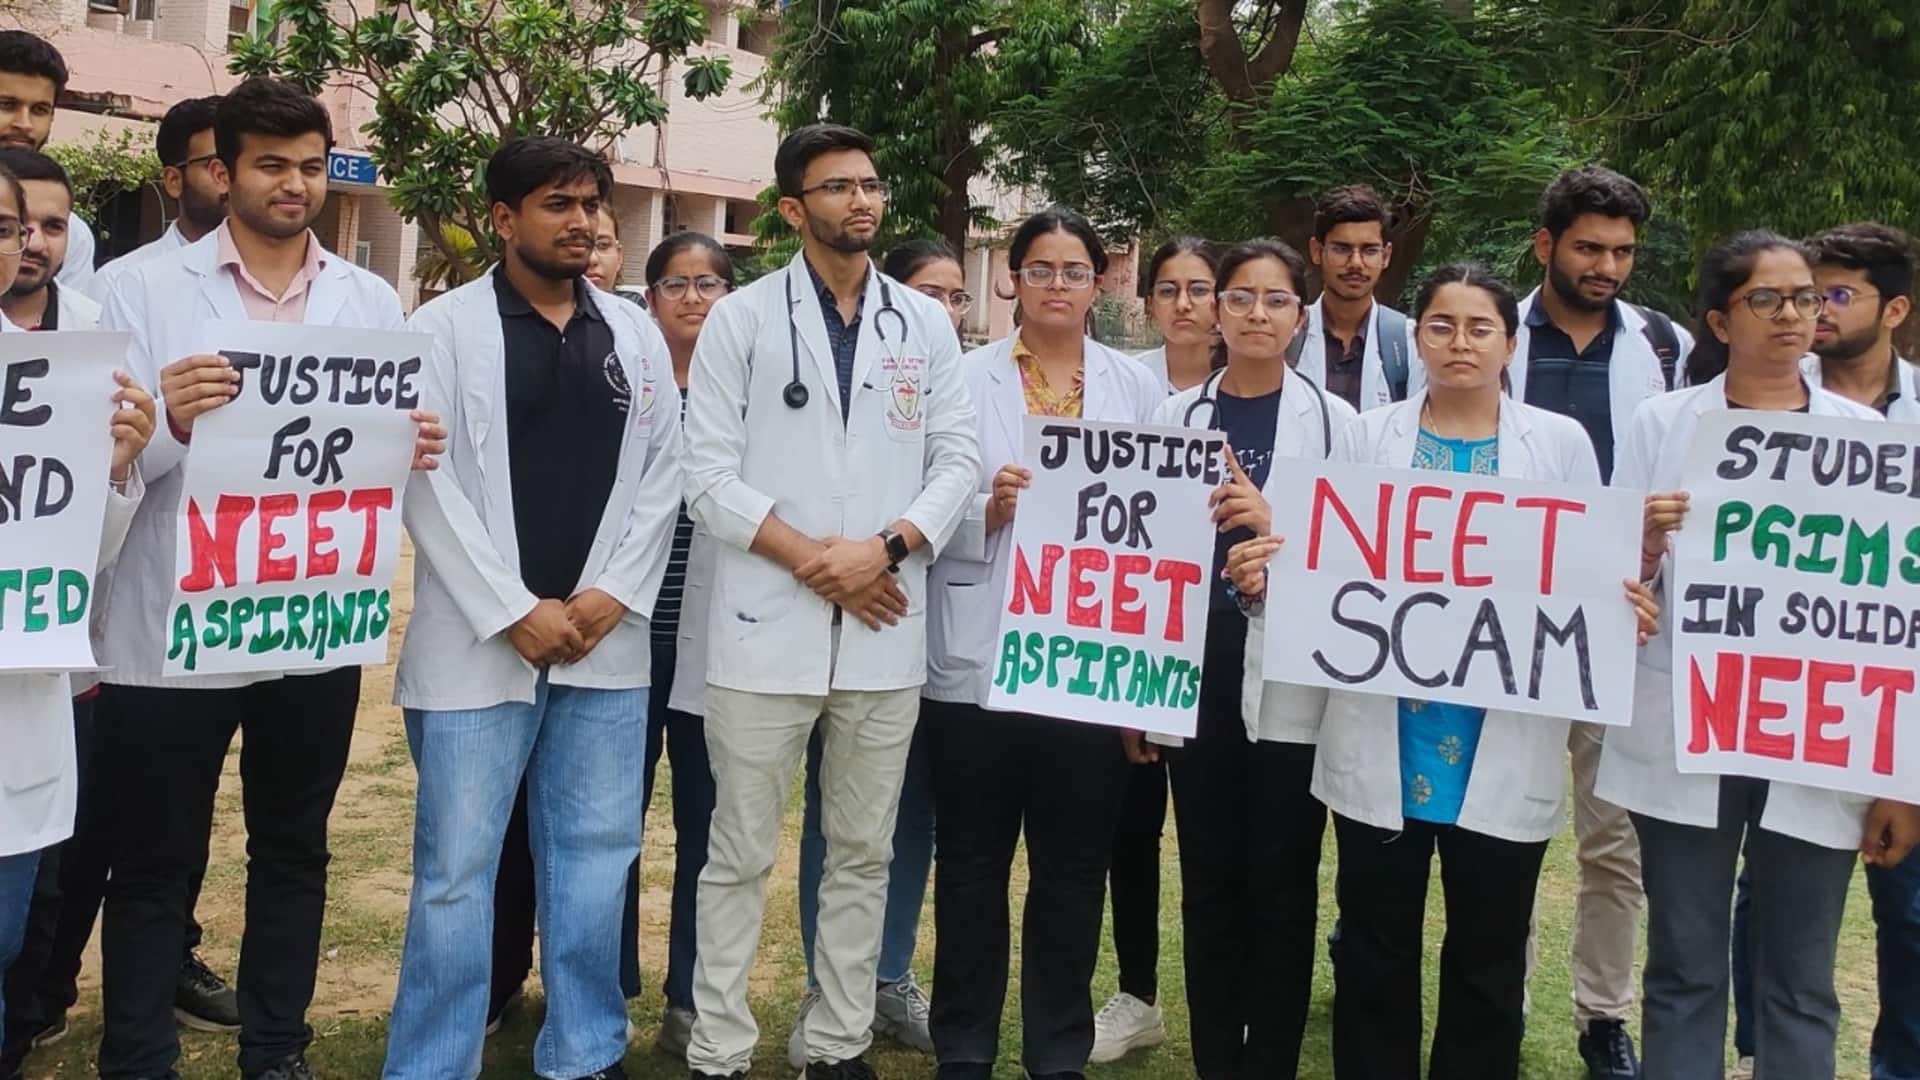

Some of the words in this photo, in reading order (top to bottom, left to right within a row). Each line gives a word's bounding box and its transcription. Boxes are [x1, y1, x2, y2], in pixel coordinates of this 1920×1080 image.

[217, 350, 422, 410] JUSTICE
[264, 416, 353, 485] FOR
[1040, 424, 1224, 486] JUSTICE
[1716, 425, 1920, 499] STUDE
[180, 488, 393, 592] NEET
[1074, 481, 1157, 549] FOR
[1307, 477, 1587, 595] NEET
[168, 589, 390, 671] ASPIRANTS
[1008, 543, 1202, 642] NEET
[1681, 583, 1764, 637] IN
[994, 630, 1201, 709] ASPIRANTS
[1312, 581, 1598, 710] SCAM
[1687, 651, 1914, 776] NEET
